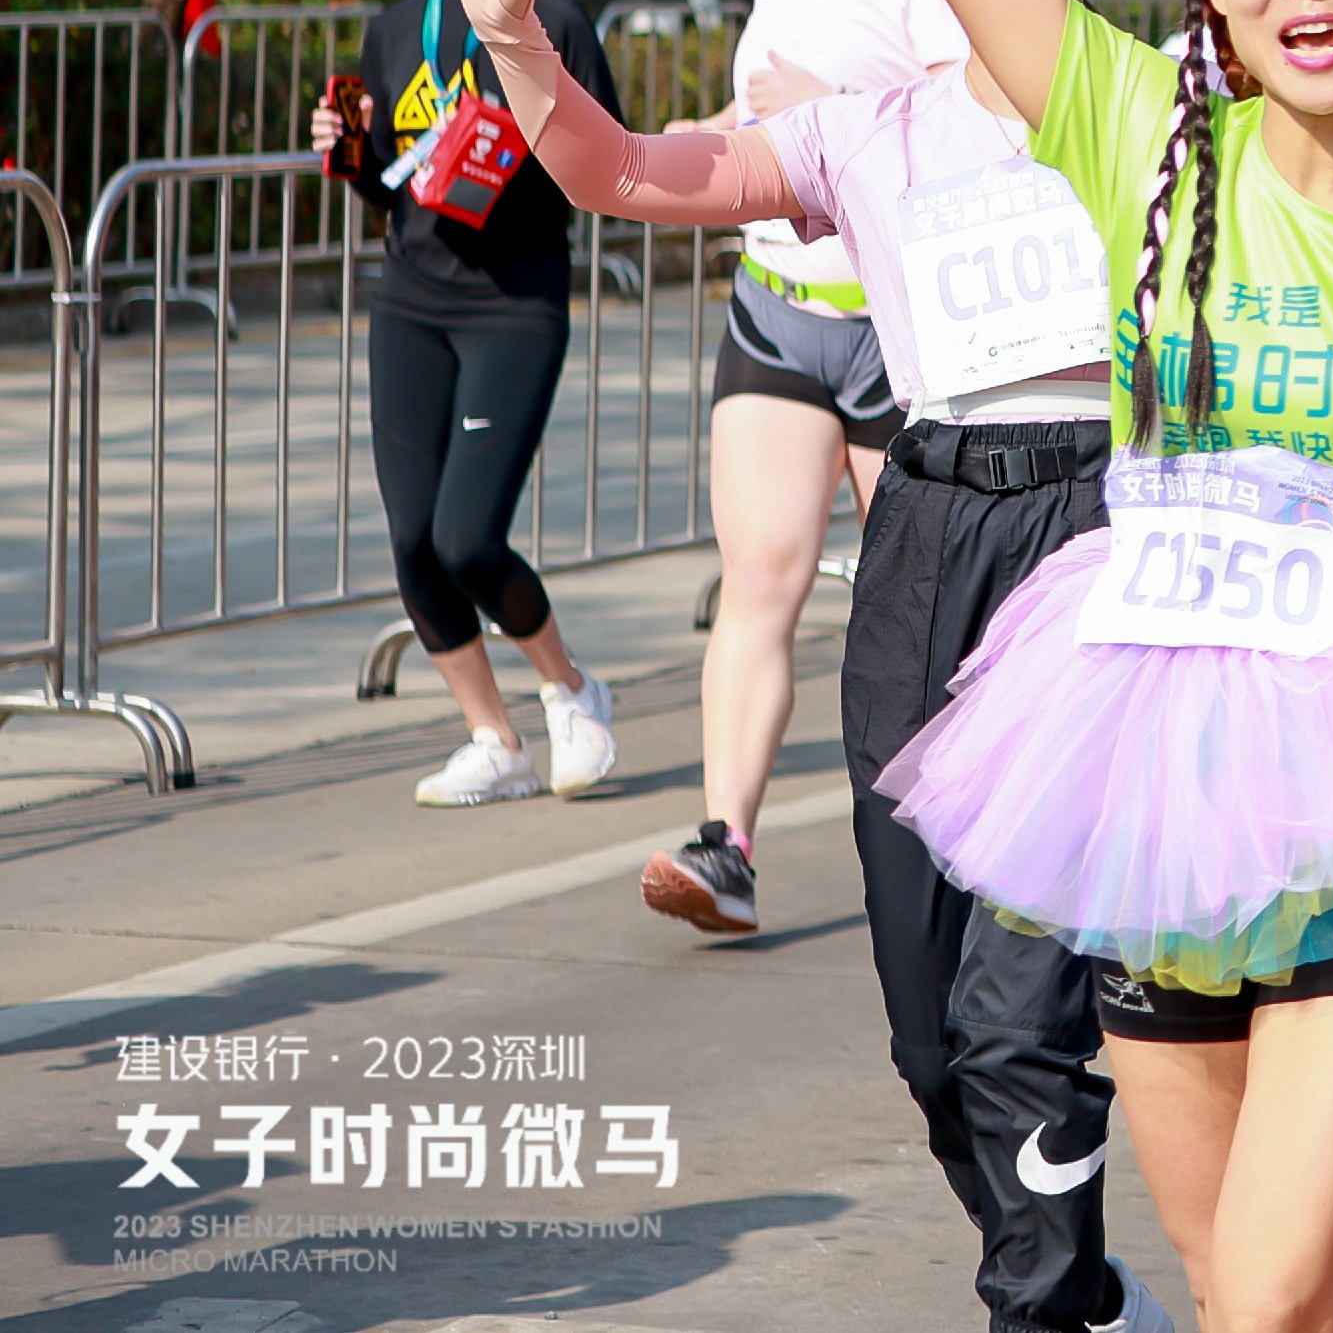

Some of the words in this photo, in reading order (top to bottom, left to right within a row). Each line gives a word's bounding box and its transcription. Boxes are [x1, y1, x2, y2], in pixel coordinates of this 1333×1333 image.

[1224, 282, 1321, 328] 我是
[1120, 472, 1261, 513] 女子时尚微马
[1123, 531, 1323, 625] C1550
